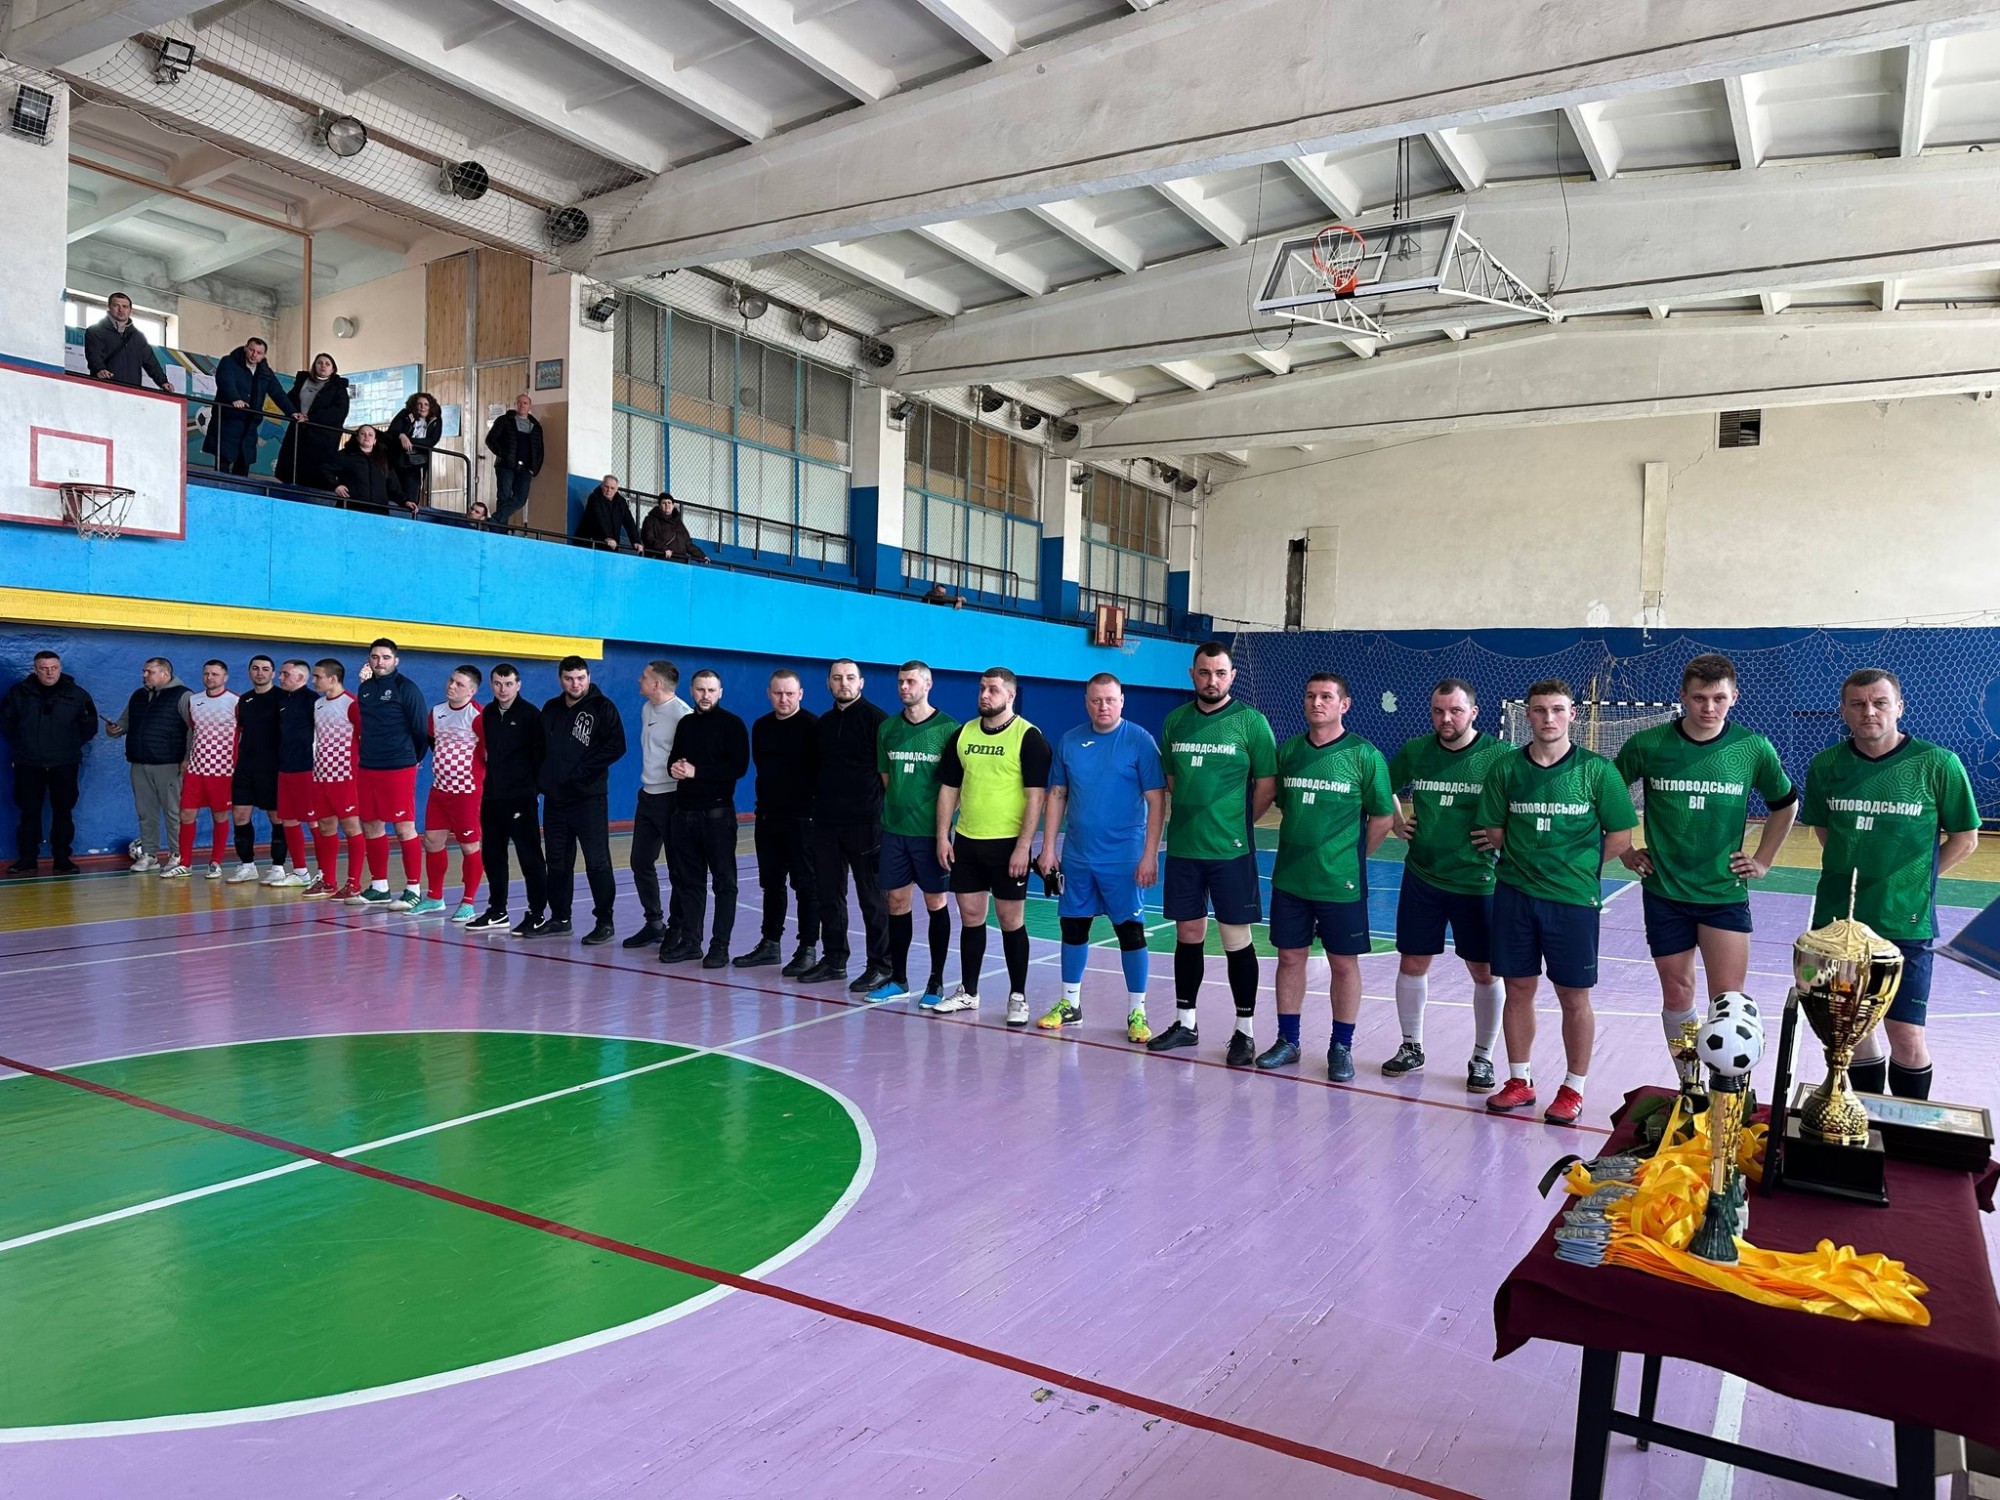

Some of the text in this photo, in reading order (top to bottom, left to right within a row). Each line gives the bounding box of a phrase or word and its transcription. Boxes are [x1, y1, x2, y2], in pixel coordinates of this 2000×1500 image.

[1191, 756, 1203, 767] ВП
[903, 763, 915, 773] ВП
[1302, 792, 1315, 804] ВП
[1440, 795, 1454, 806] ВП
[1688, 796, 1705, 810] ВП
[1536, 818, 1551, 831] ВП
[1855, 816, 1874, 831] ВП
